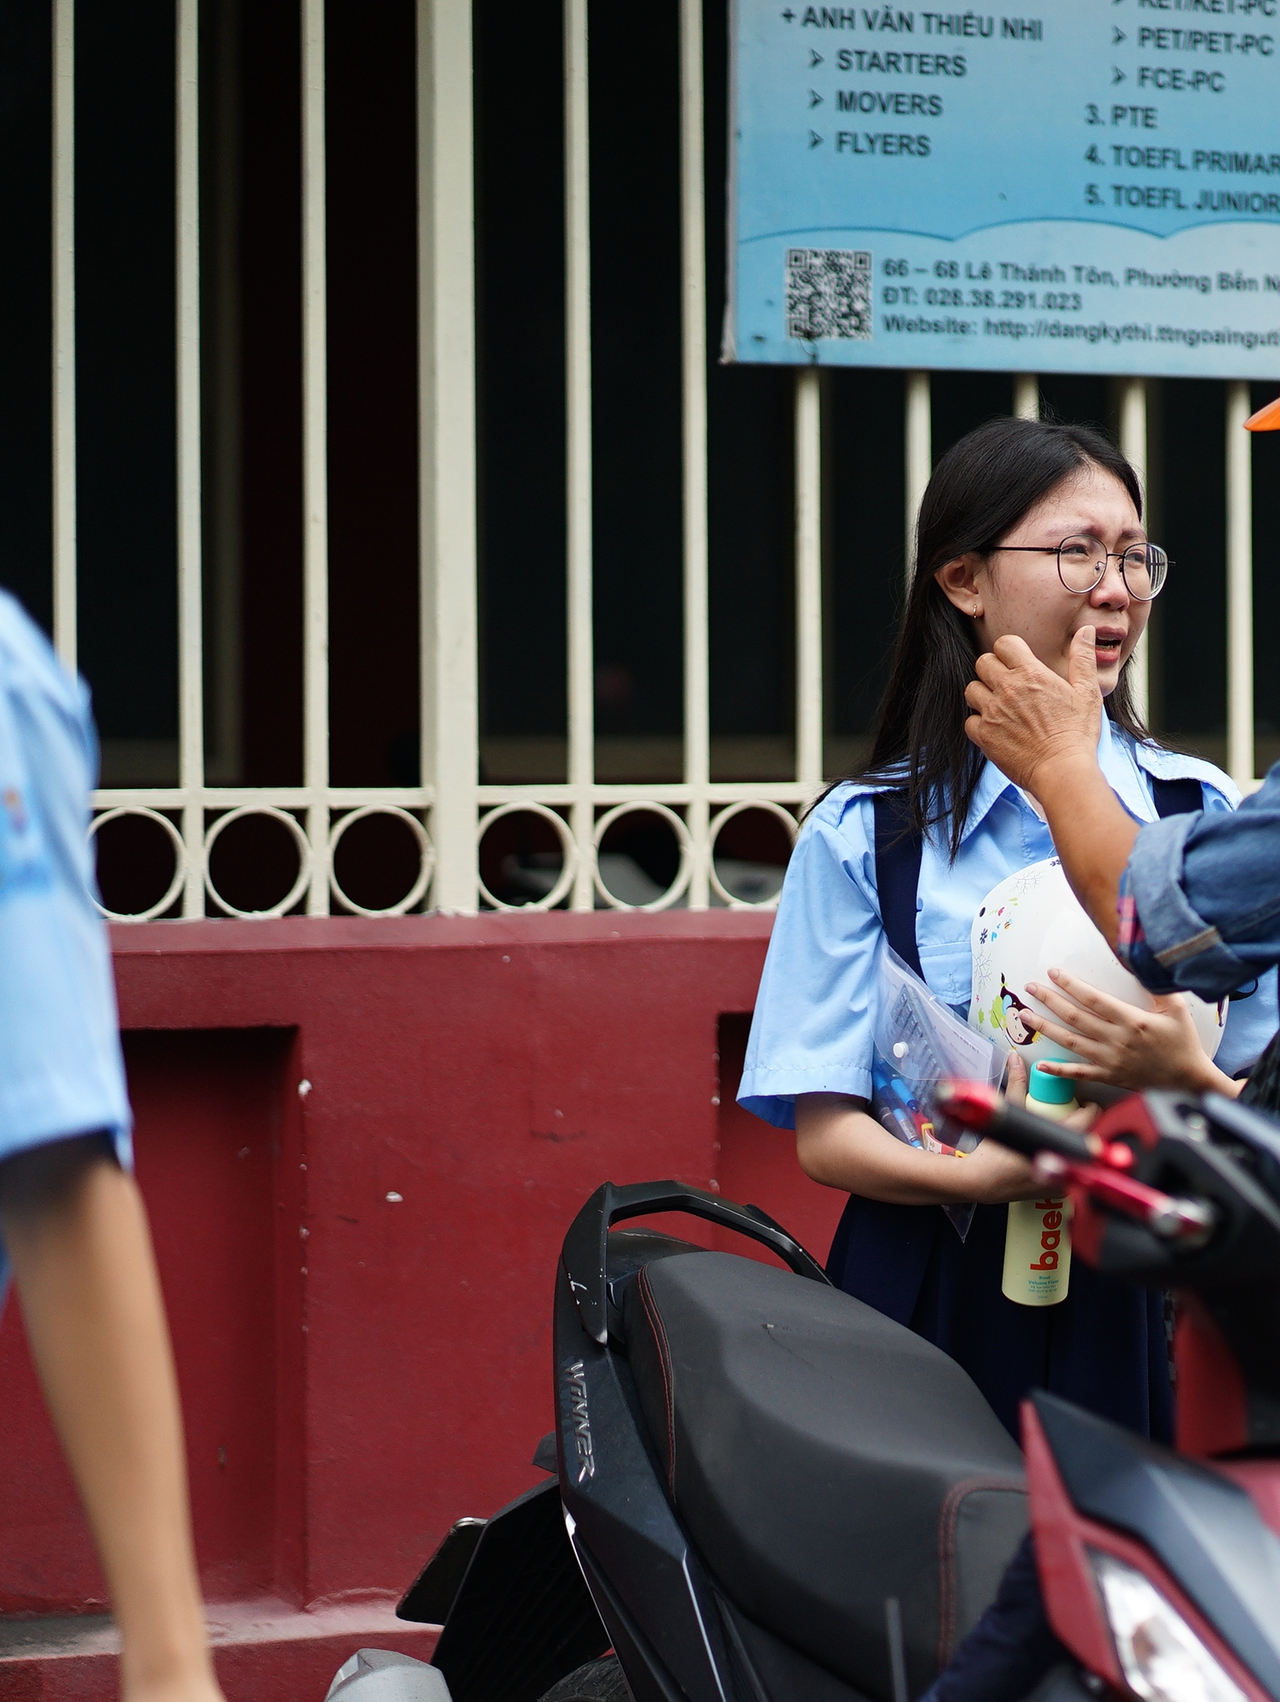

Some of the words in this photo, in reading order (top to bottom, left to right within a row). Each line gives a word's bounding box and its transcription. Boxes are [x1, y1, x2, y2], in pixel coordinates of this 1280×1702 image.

[863, 5, 914, 33] VĂN
[1001, 17, 1042, 41] NHI
[1138, 26, 1275, 56] PET/PET-PC
[837, 49, 967, 77] STARTERS
[1137, 66, 1226, 93] FCE-PC
[836, 90, 943, 116] MOVERS
[1085, 103, 1105, 126] 3.
[1112, 105, 1158, 129] PTE
[836, 131, 932, 157] FLYERS
[1084, 143, 1105, 166] 4.
[1111, 144, 1188, 170] TOEFL
[1085, 183, 1105, 206] 5.
[1111, 184, 1188, 210] TOEFL
[882, 258, 909, 277] 66
[933, 259, 960, 279] 68
[965, 260, 993, 281] Lê
[882, 314, 977, 336] Website:
[563, 1358, 596, 1482] WINNER
